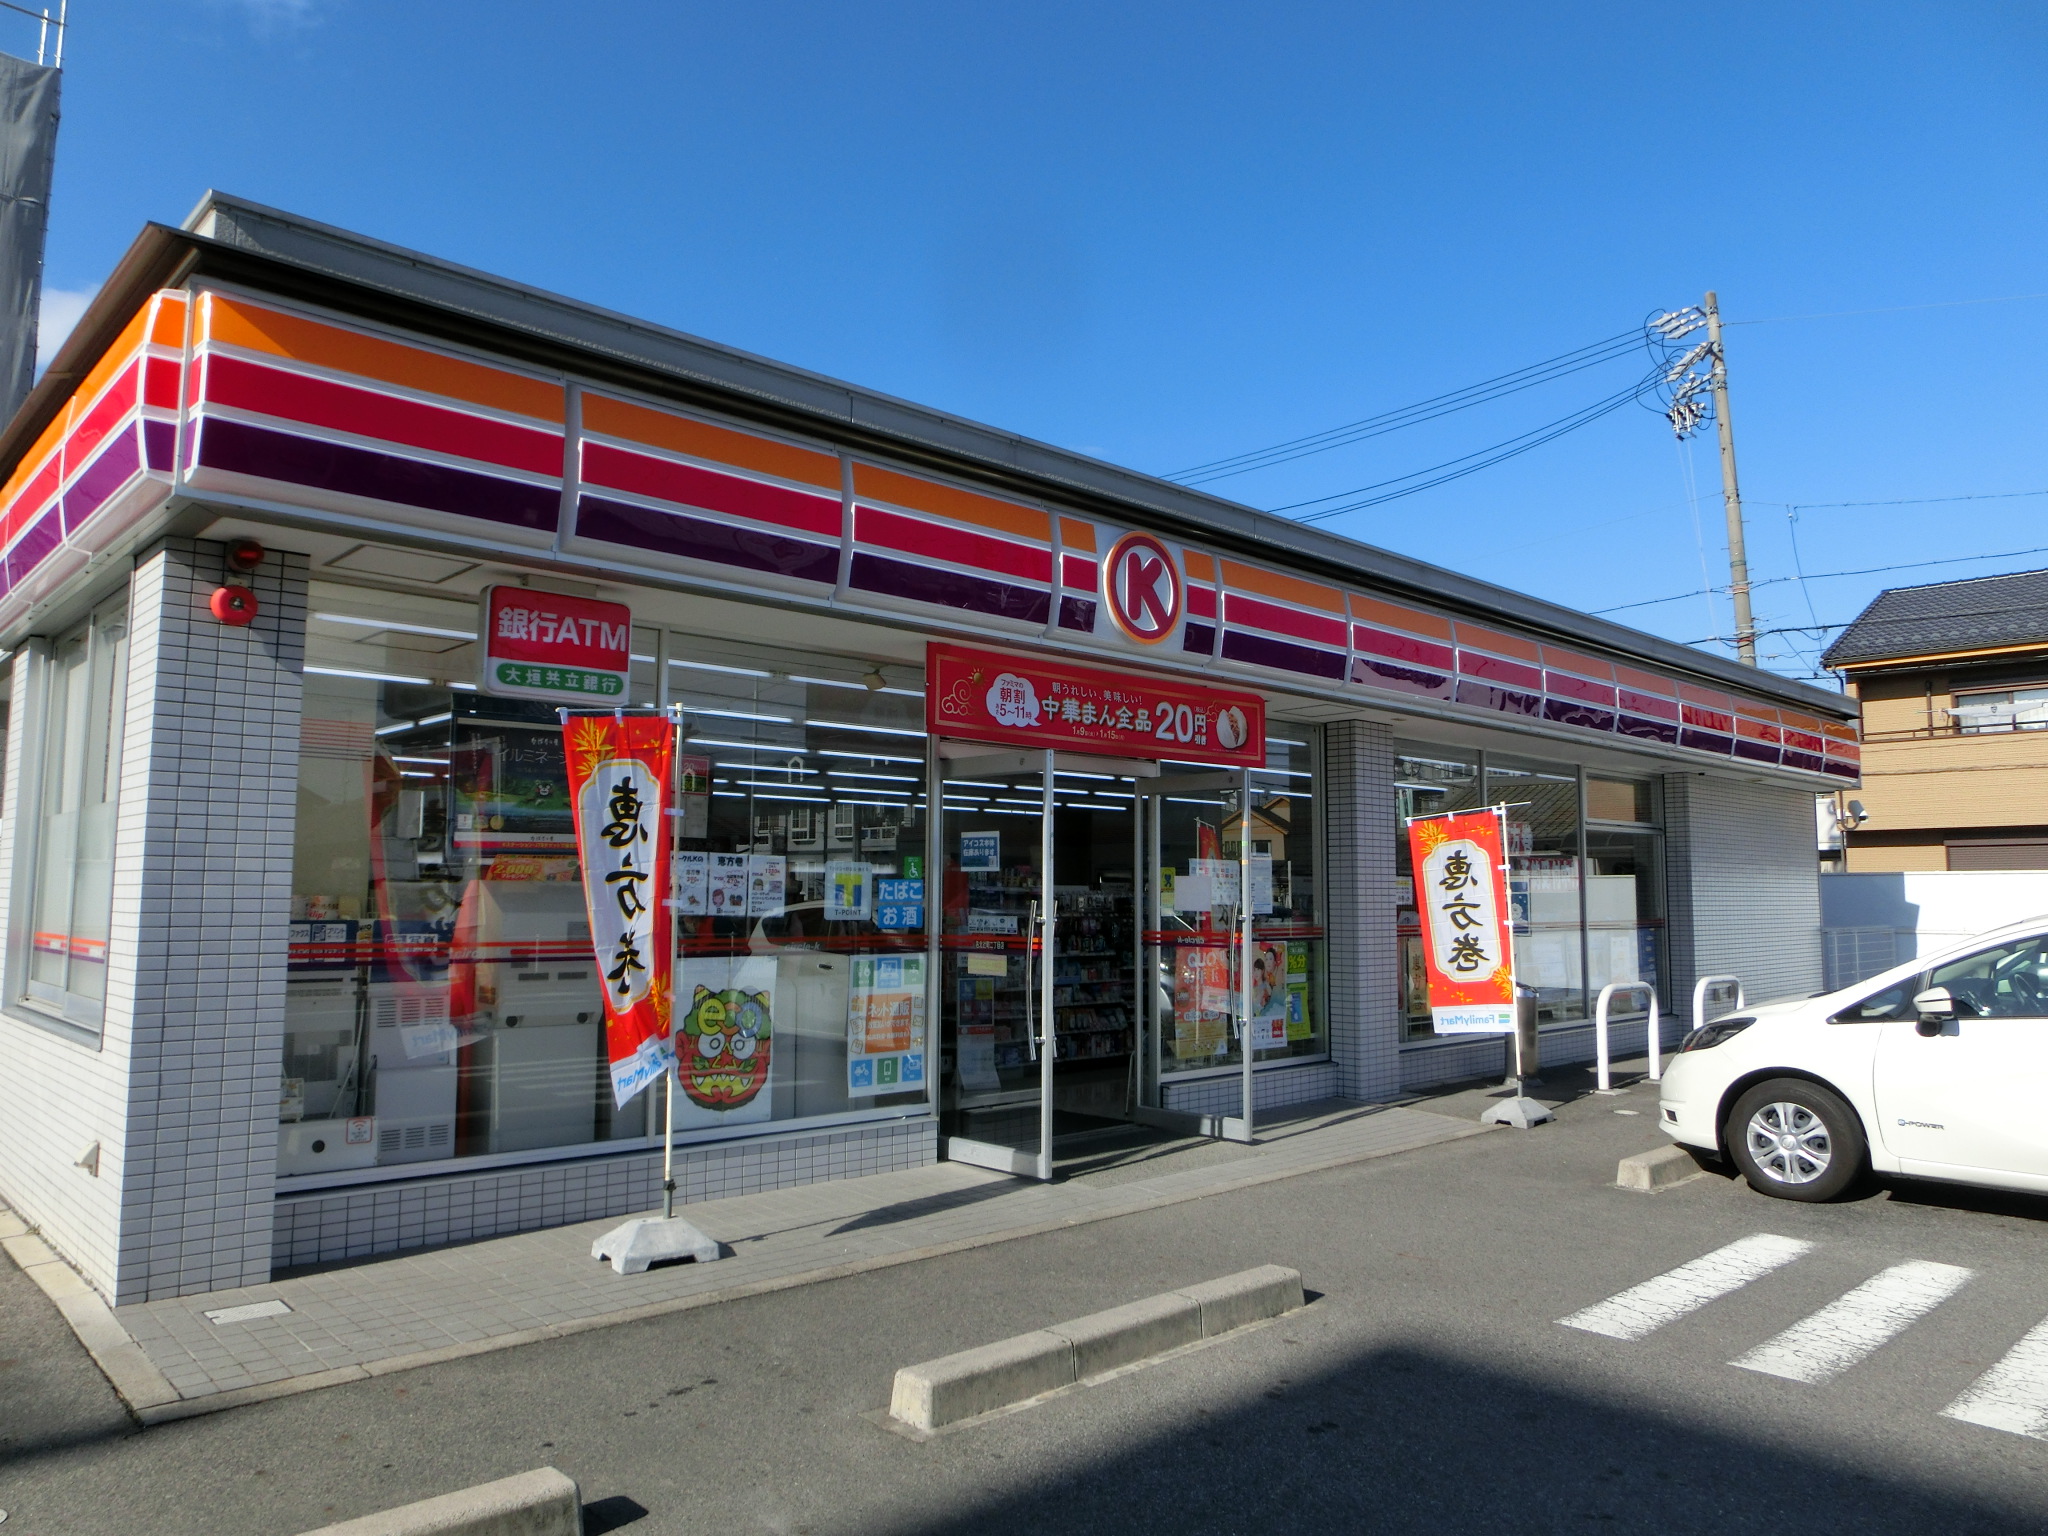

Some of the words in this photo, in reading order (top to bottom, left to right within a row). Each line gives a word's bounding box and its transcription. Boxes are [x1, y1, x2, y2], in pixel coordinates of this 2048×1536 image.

[1126, 552, 1170, 630] K
[498, 607, 627, 652] 銀行ATM
[505, 667, 617, 694] 大垣共立銀行
[1001, 679, 1024, 689] ファミマの
[1000, 687, 1026, 705] 朝割
[1041, 696, 1153, 733] 中華まん全品
[671, 855, 704, 863] ークルKの
[879, 882, 922, 900] たばこ
[883, 906, 918, 925] お酒
